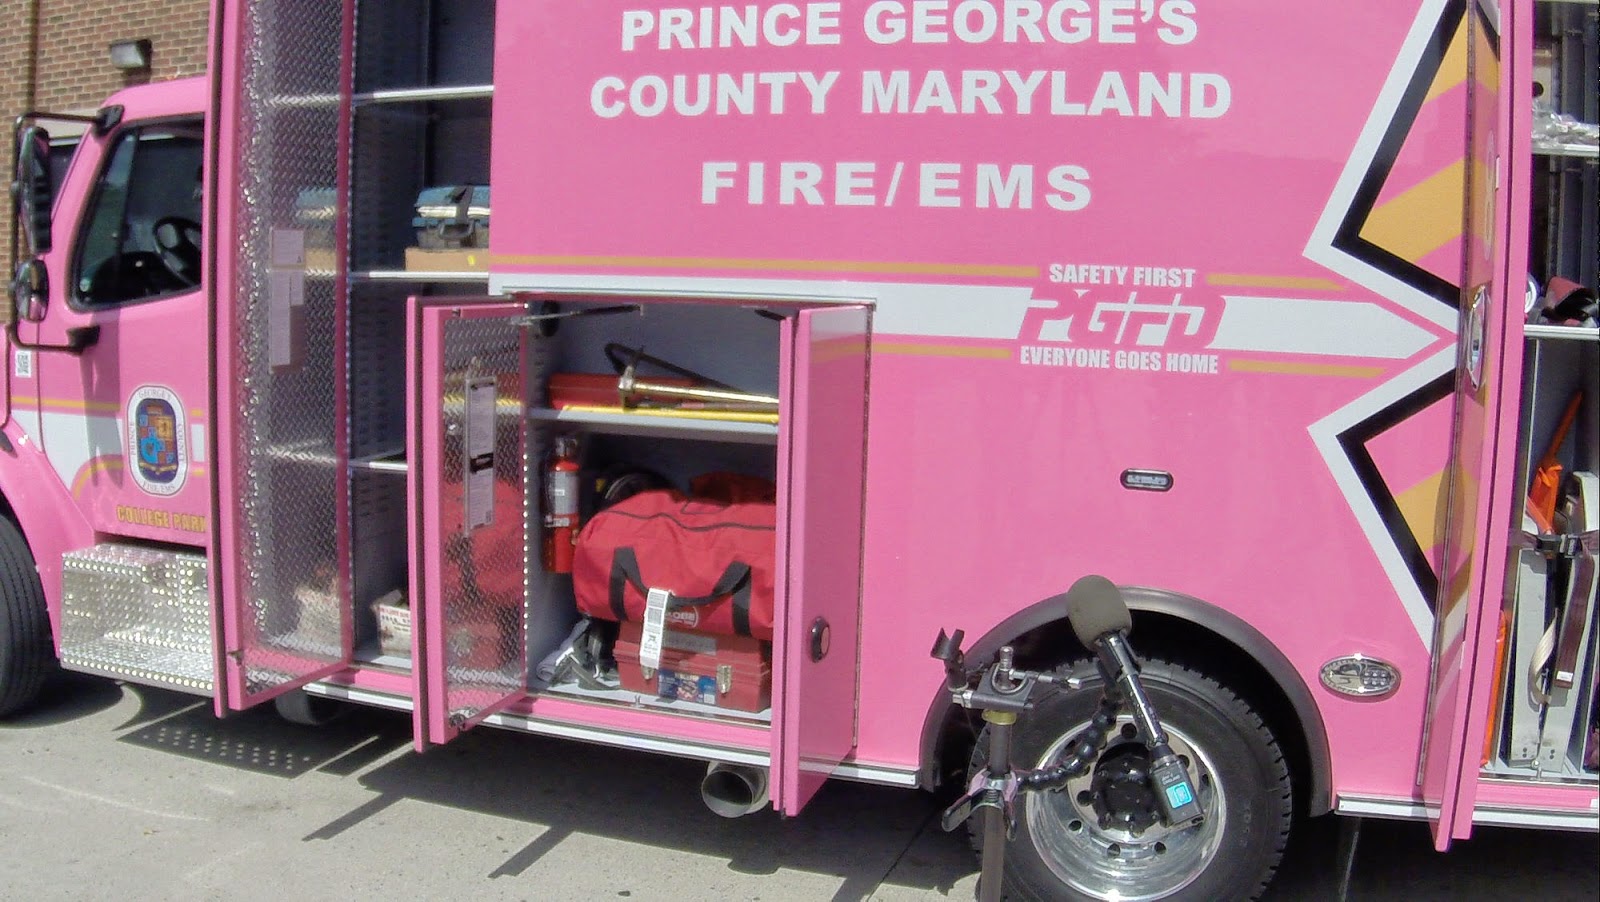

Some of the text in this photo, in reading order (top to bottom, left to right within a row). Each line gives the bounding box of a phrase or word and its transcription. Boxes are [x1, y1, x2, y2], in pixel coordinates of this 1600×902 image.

[621, 2, 841, 51] PRINCE
[590, 70, 1232, 119] COUNTY MARYLAND
[701, 161, 1092, 211] FIRE/EMS
[1049, 263, 1196, 288] SAFETY FIRST
[1020, 345, 1218, 375] EVERYONE GOES HOME
[116, 505, 170, 529] COLLEGE
